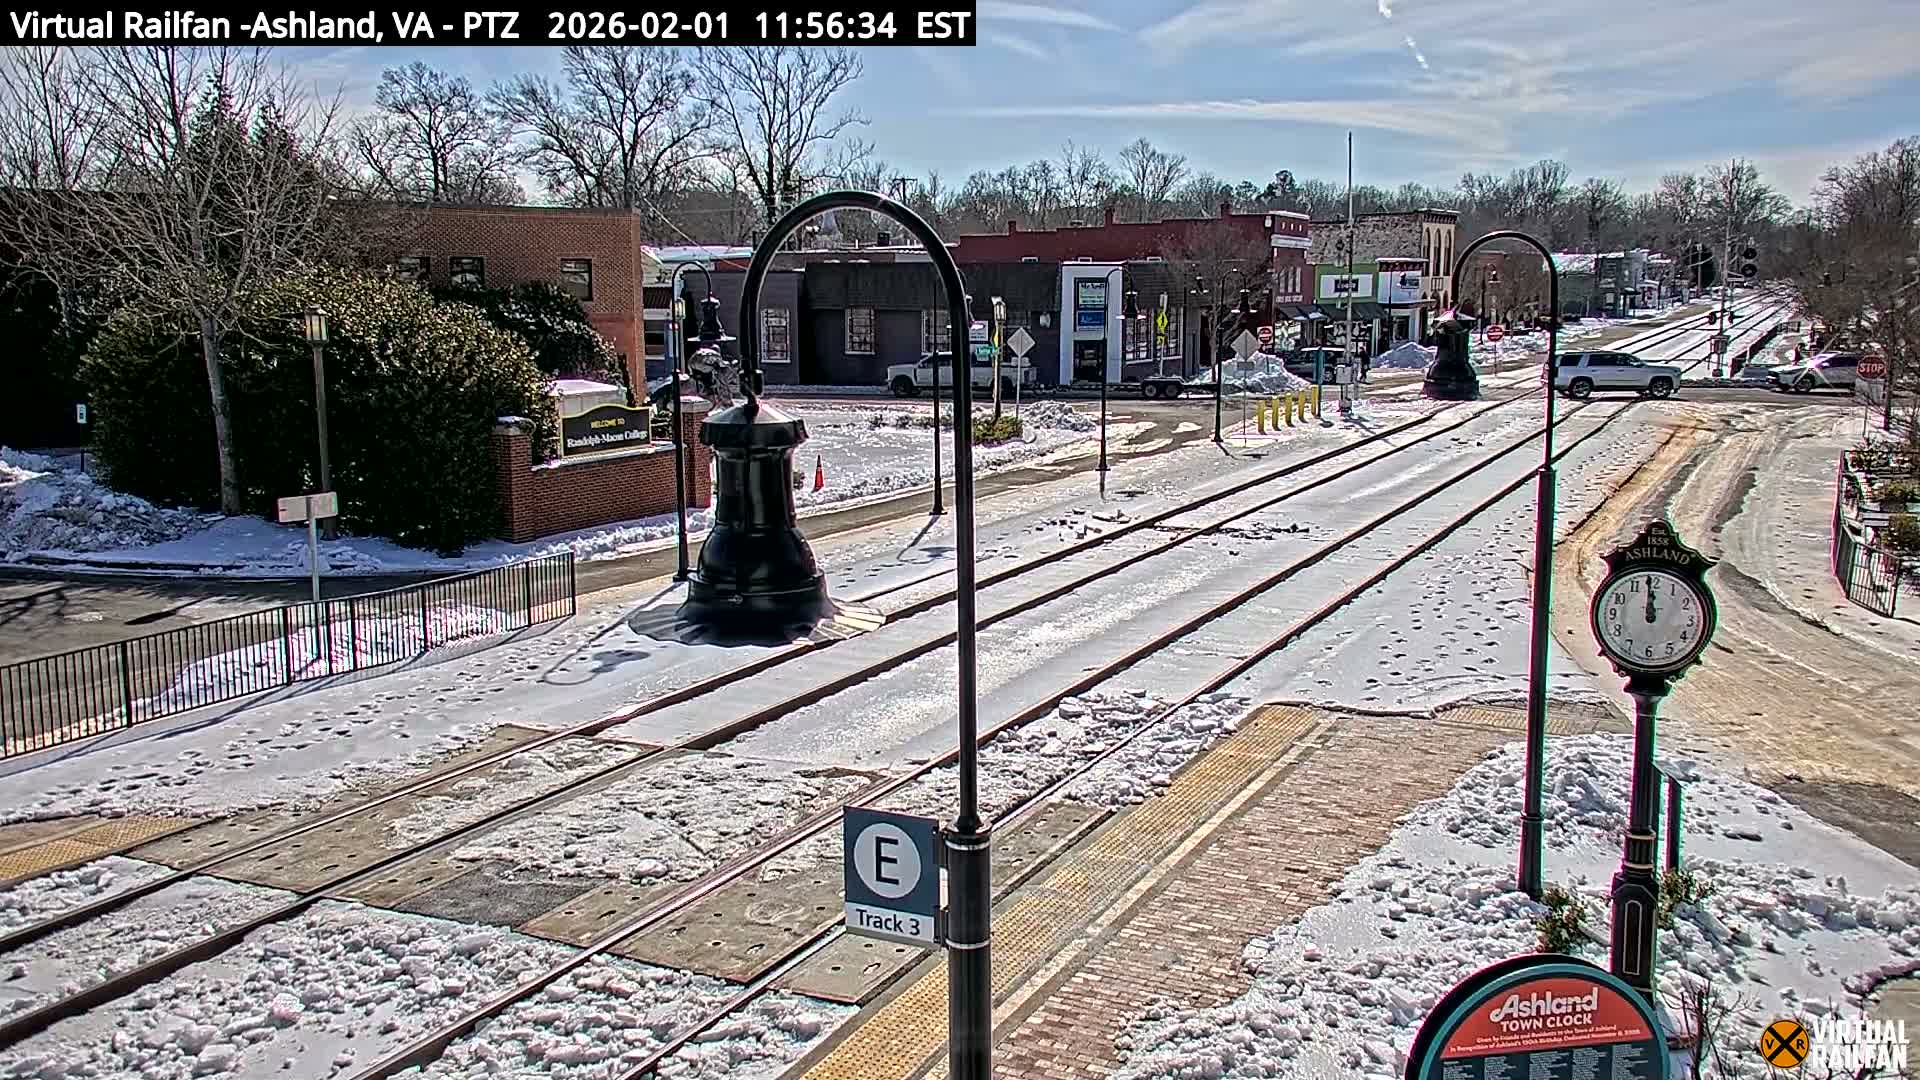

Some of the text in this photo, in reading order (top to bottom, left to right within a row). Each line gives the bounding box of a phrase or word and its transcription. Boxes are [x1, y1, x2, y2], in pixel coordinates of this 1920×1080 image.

[1860, 363, 1884, 373] STOP
[567, 429, 648, 448] Randolph-Macon College
[1625, 546, 1690, 565] ASHLAND
[1631, 581, 1639, 592] 11
[1670, 583, 1676, 596] 1
[1614, 592, 1625, 605] 10
[1682, 597, 1690, 610] 2
[1609, 608, 1617, 620] 9
[1686, 615, 1694, 627] 3
[1613, 624, 1621, 636] 8
[1680, 631, 1688, 643] 4
[1625, 639, 1633, 654] 7
[1645, 645, 1653, 657] 6
[1665, 642, 1674, 655] 5
[875, 836, 899, 885] E
[855, 908, 920, 936] Track 3
[1489, 986, 1599, 1022] Ashland
[1500, 1013, 1593, 1032] TOWN CLOCK
